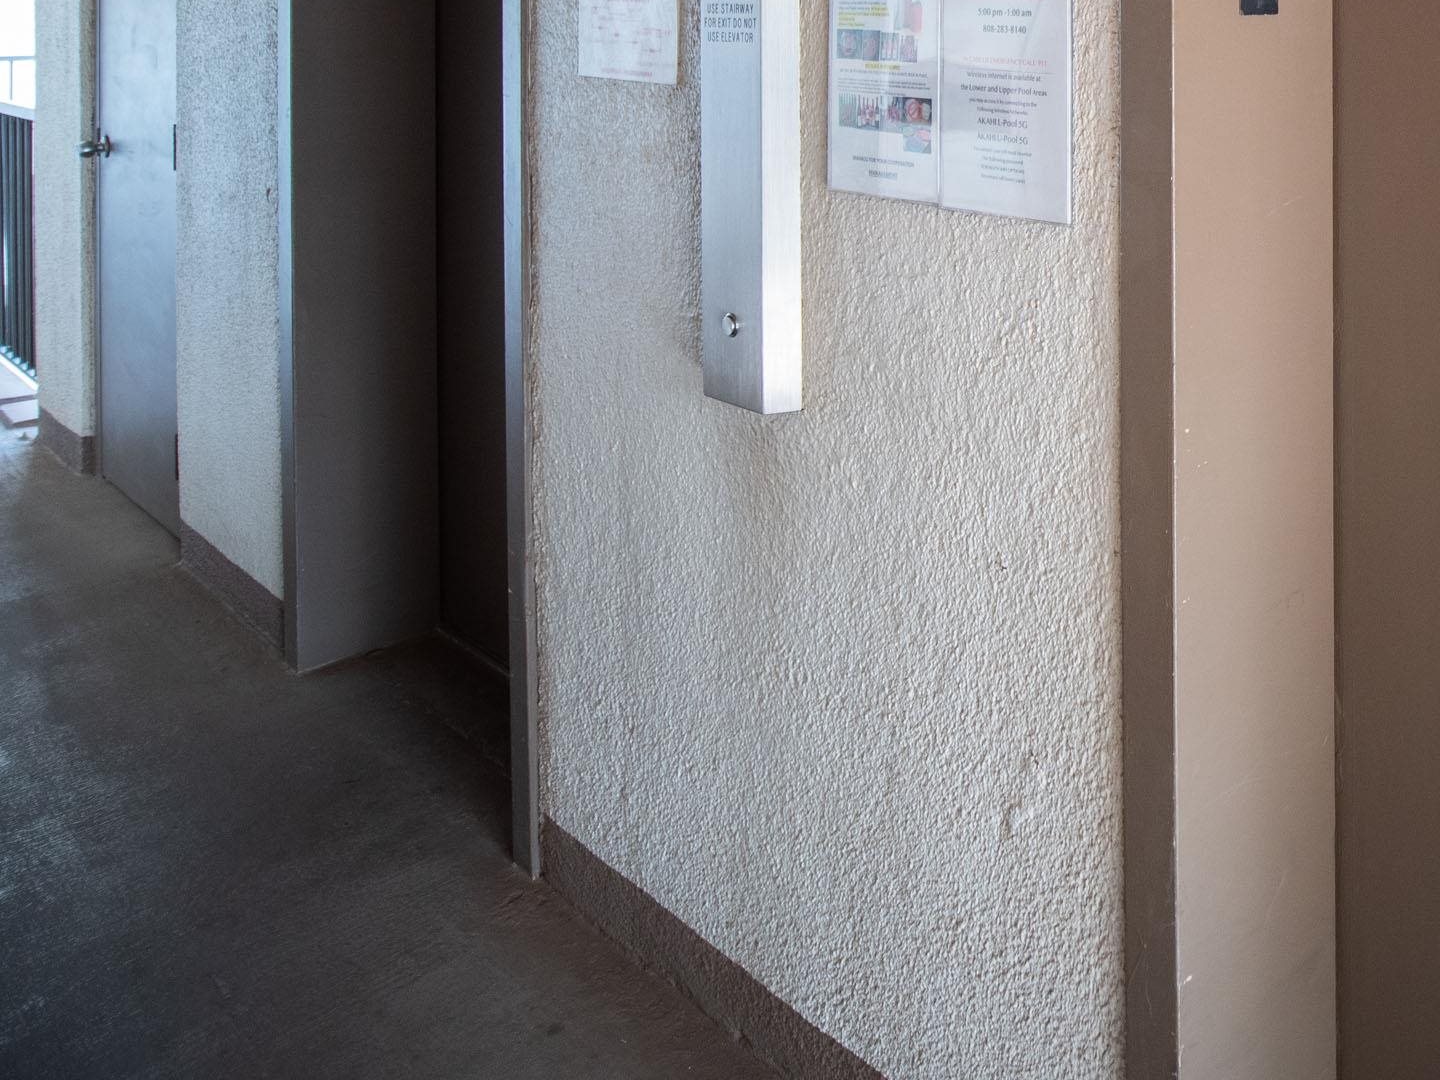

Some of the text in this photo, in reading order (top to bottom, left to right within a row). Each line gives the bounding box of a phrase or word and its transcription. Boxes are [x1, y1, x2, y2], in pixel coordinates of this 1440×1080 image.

[707, 3, 754, 14] USE STAIRWAY
[992, 9, 1003, 18] pm
[1021, 9, 1032, 17] am
[704, 17, 756, 28] FOR EXIT DO NOT
[707, 31, 754, 43] USE ELEVATOR
[960, 83, 968, 91] the
[969, 84, 986, 92] Lower
[987, 85, 999, 93] and
[1018, 87, 1032, 95] Pool
